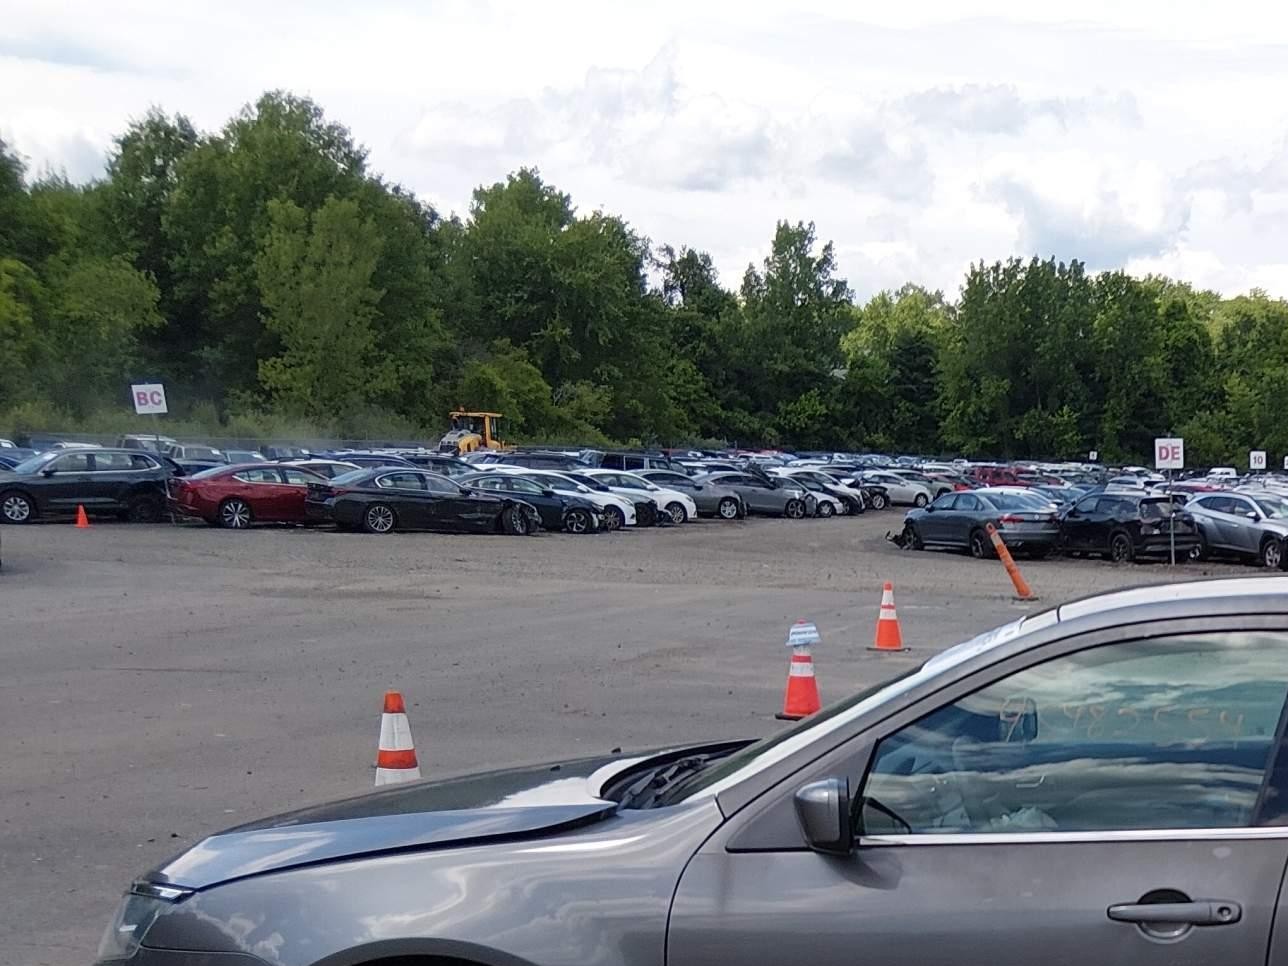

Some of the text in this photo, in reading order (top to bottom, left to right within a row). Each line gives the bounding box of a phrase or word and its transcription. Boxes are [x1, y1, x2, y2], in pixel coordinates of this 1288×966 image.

[136, 391, 162, 406] BC
[1158, 445, 1181, 460] DE
[1253, 455, 1264, 464] 10
